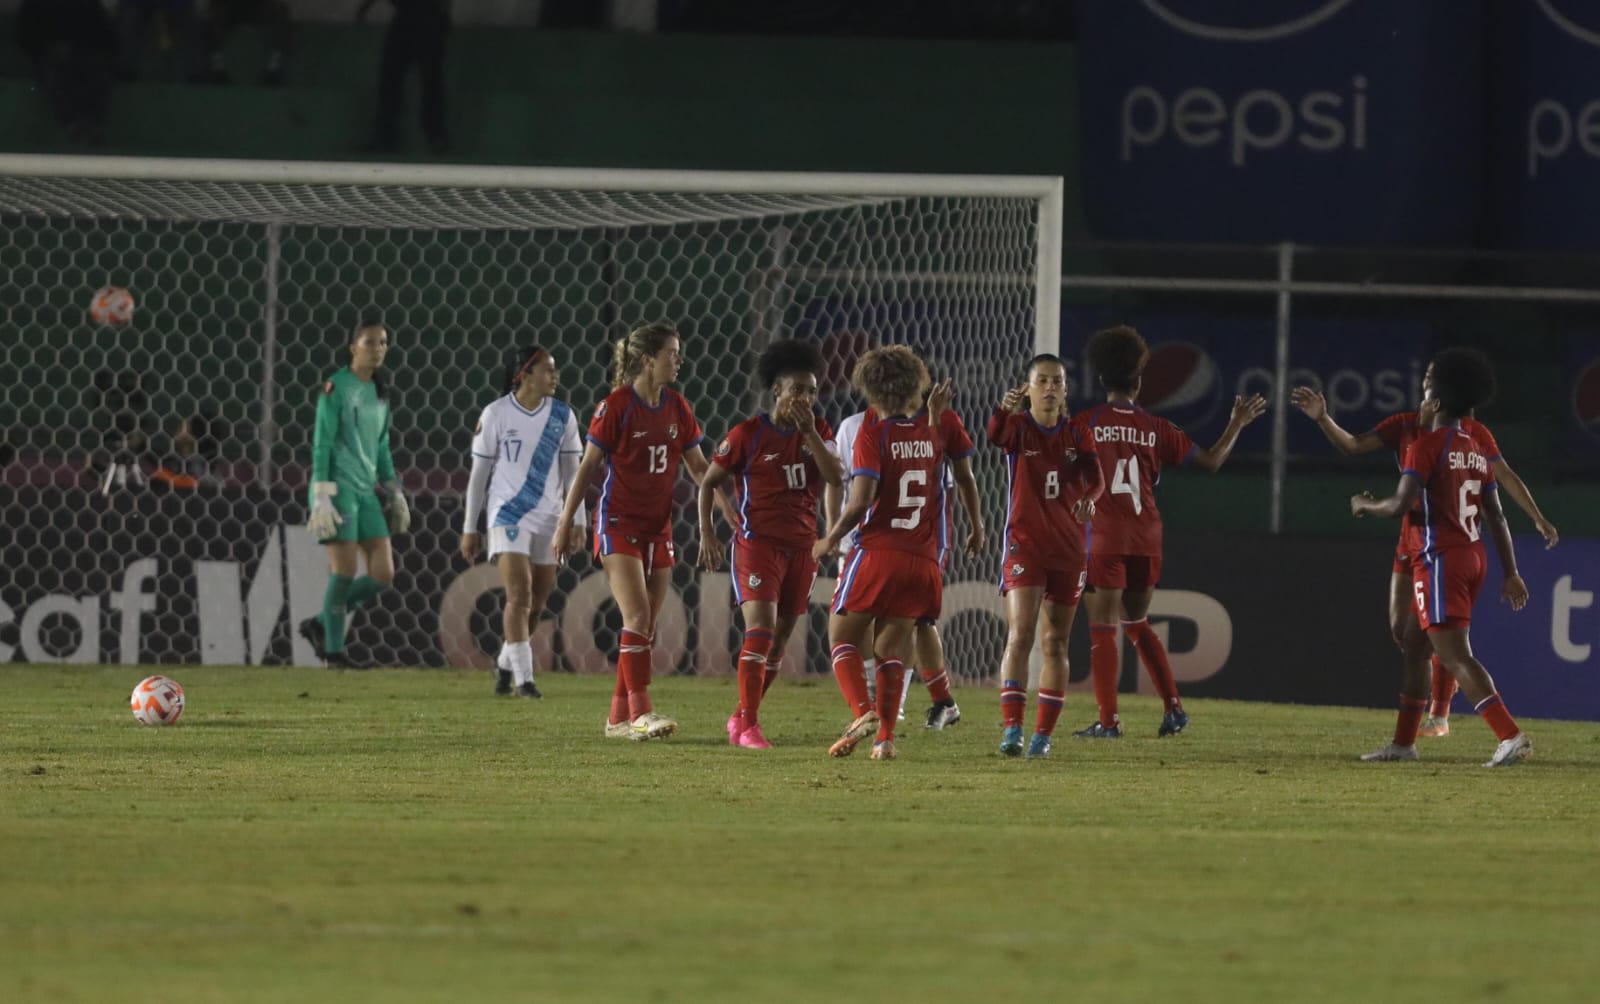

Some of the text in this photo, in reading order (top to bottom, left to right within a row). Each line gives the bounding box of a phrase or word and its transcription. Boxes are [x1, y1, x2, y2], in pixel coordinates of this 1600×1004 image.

[1120, 75, 1368, 167] pepsi
[1236, 360, 1422, 415] ppsi
[504, 439, 522, 463] 17
[890, 440, 934, 460] PINZON
[1094, 426, 1156, 448] CASTILLO
[648, 444, 668, 474] 13
[782, 463, 807, 490] 10
[891, 469, 927, 530] 5
[1044, 470, 1060, 499] 8
[1110, 454, 1142, 516] 4
[1458, 479, 1482, 543] 6
[0, 557, 158, 664] af
[1413, 580, 1426, 611] 6
[1551, 573, 1594, 663] t
